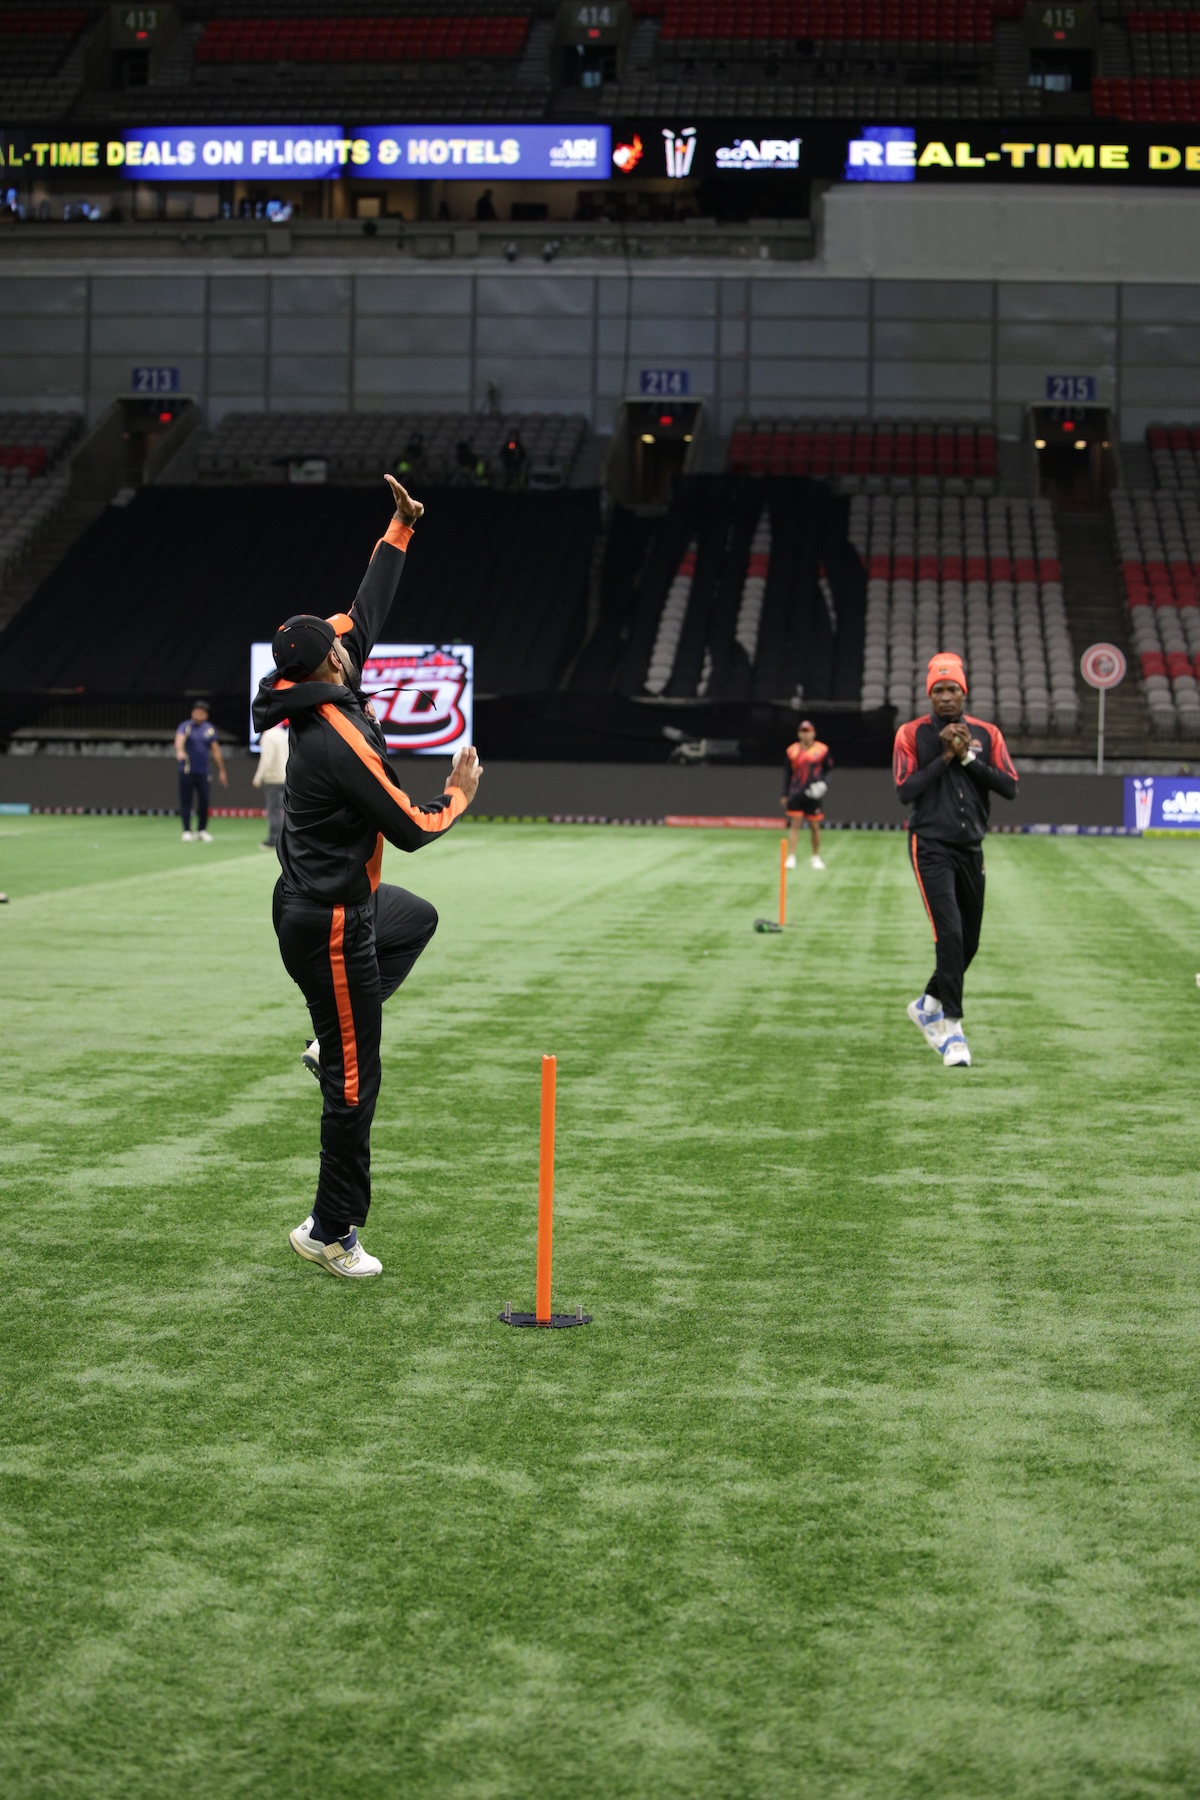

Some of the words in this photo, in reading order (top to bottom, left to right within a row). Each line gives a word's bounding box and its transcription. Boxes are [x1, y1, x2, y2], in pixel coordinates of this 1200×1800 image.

[125, 10, 157, 30] 413
[577, 6, 610, 26] 414
[1042, 8, 1076, 28] 415
[107, 140, 196, 166] DEALS
[203, 140, 244, 166] ON
[252, 139, 370, 165] FLIGHTS
[378, 140, 401, 165] &
[408, 139, 520, 165] HOTELS
[849, 140, 1129, 168] REAL-TIME
[138, 368, 172, 391] 213
[646, 371, 682, 394] 214
[1053, 377, 1089, 399] 215
[361, 664, 464, 683] UPER
